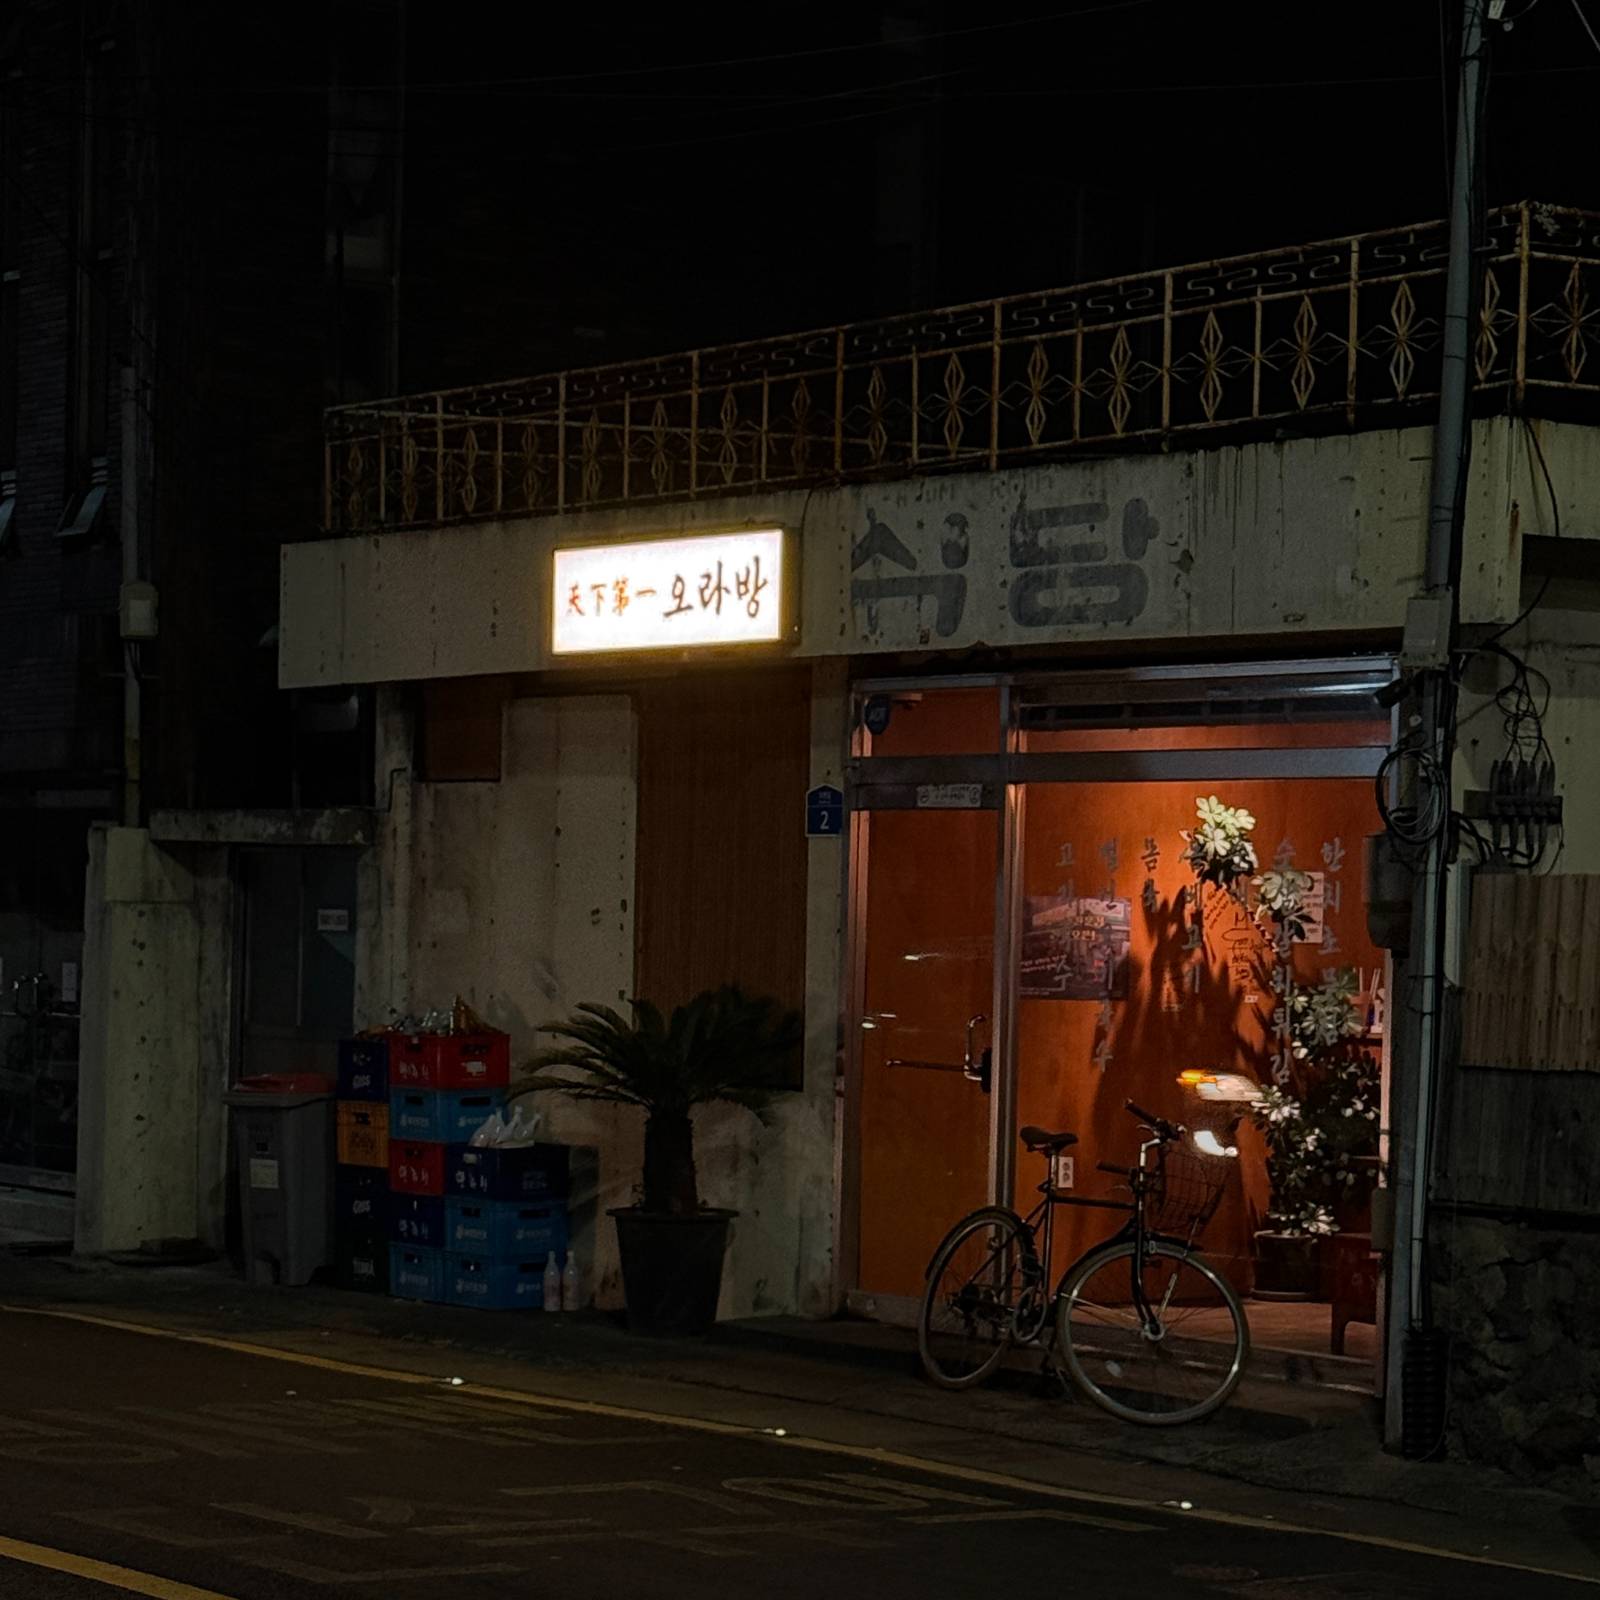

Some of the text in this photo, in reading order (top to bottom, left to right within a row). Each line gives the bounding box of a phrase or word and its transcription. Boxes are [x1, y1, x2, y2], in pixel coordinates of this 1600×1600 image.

[567, 555, 768, 618] 天下第一 오라방
[850, 497, 1160, 638] 식당
[820, 810, 830, 830] 2
[1270, 839, 1296, 1085] 순갈치튀김
